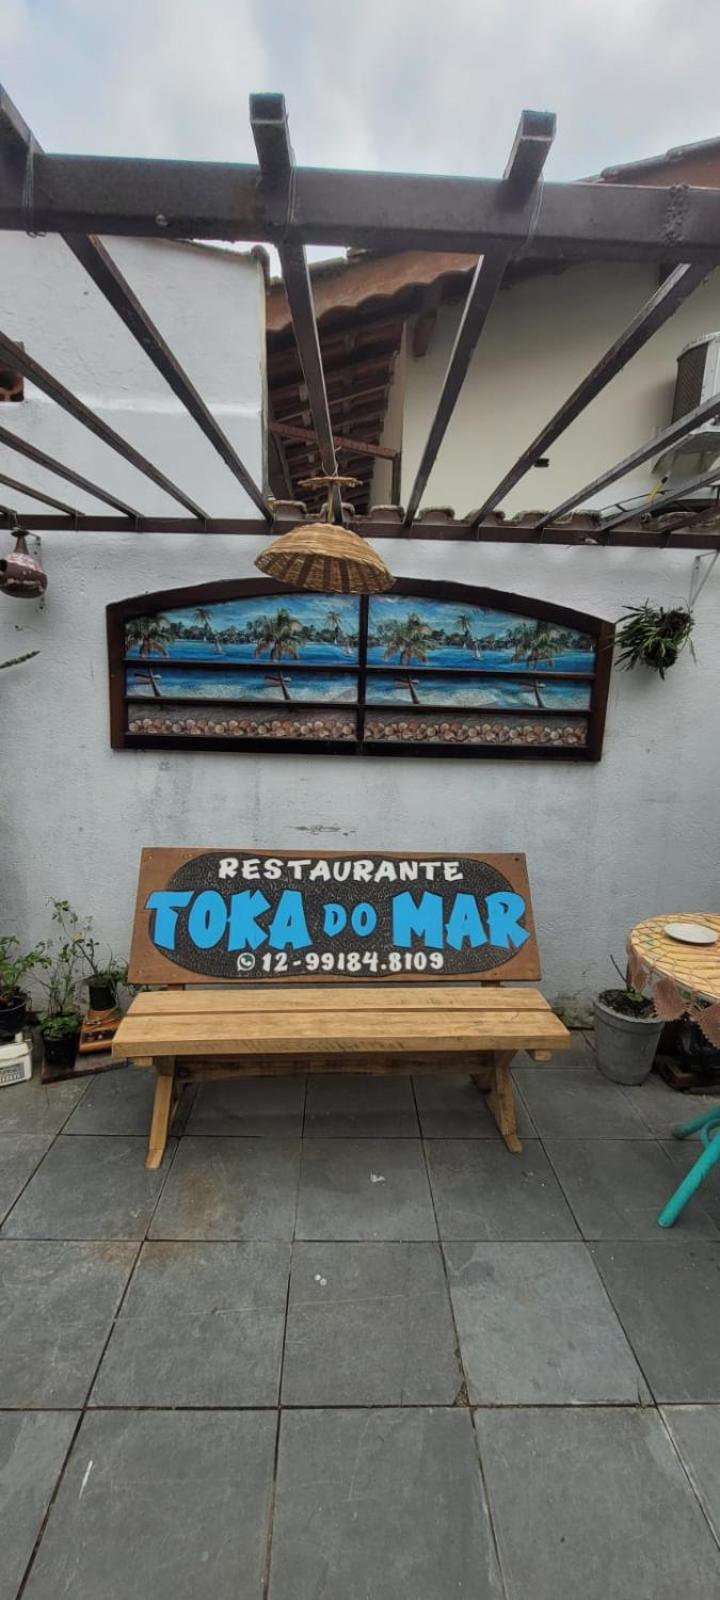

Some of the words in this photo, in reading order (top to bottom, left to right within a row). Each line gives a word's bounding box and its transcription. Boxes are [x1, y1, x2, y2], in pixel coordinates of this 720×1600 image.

[218, 857, 464, 882] RESTAURANTE
[145, 889, 312, 951] TOKA
[323, 902, 378, 938] DO
[392, 890, 531, 949] MAR
[261, 951, 445, 973] 12-99184.8109
